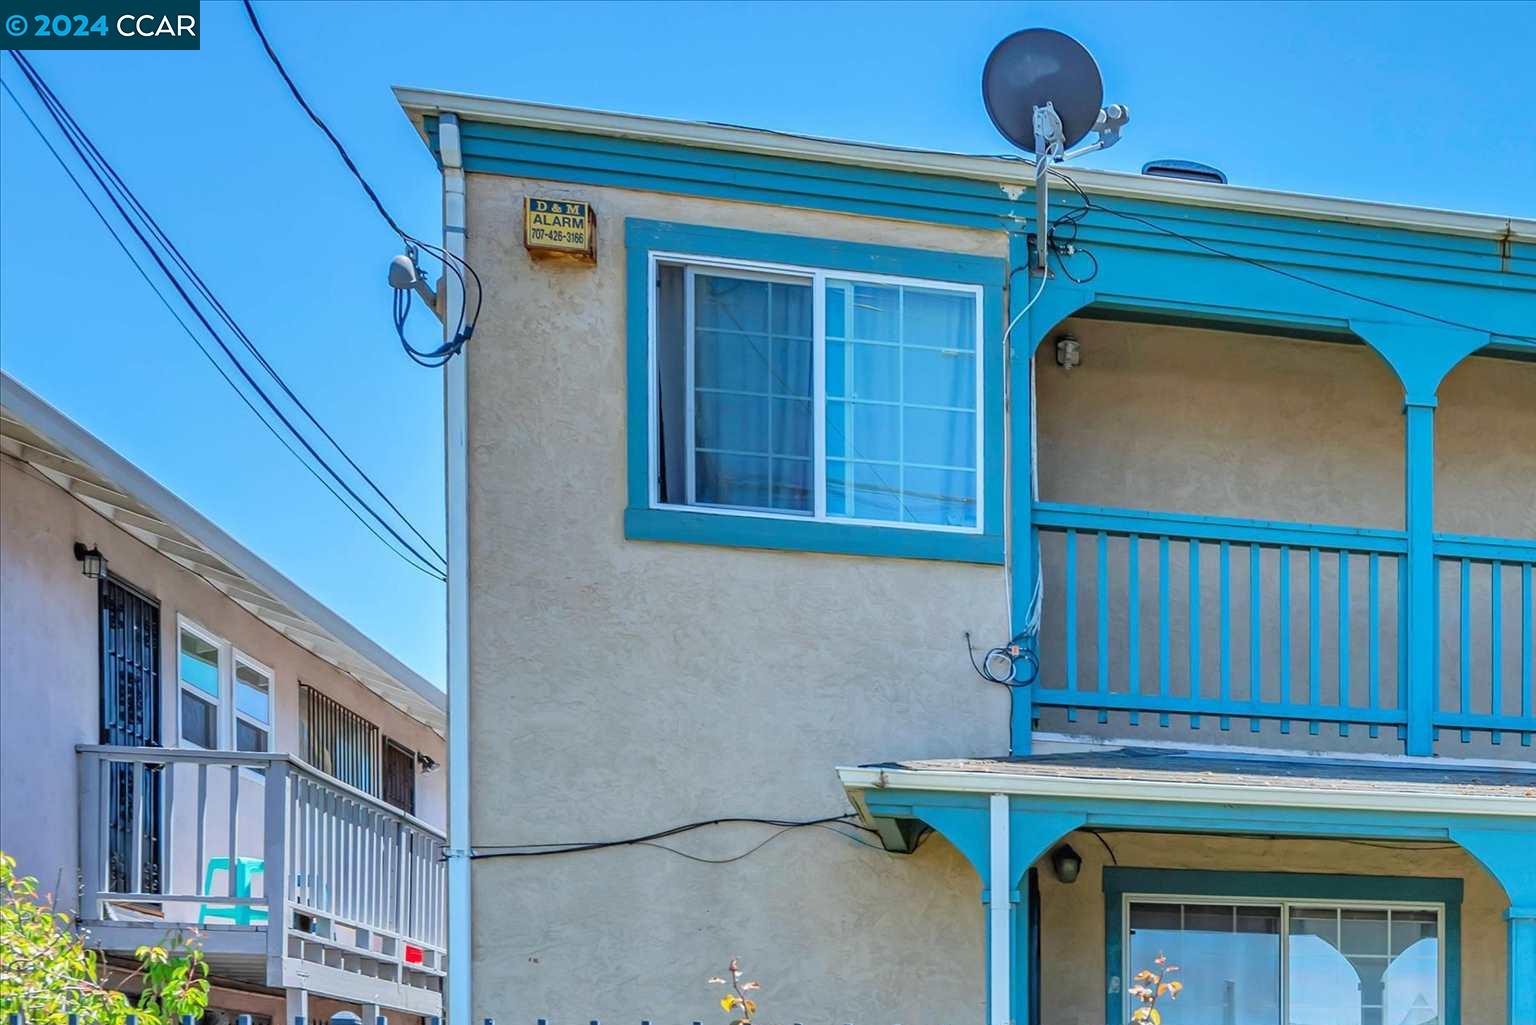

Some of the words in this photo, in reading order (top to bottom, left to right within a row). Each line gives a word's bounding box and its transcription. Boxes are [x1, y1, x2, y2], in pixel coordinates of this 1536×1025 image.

[535, 200, 548, 211] D
[551, 203, 562, 213] &
[565, 204, 580, 215] M
[533, 214, 584, 229] ALARM
